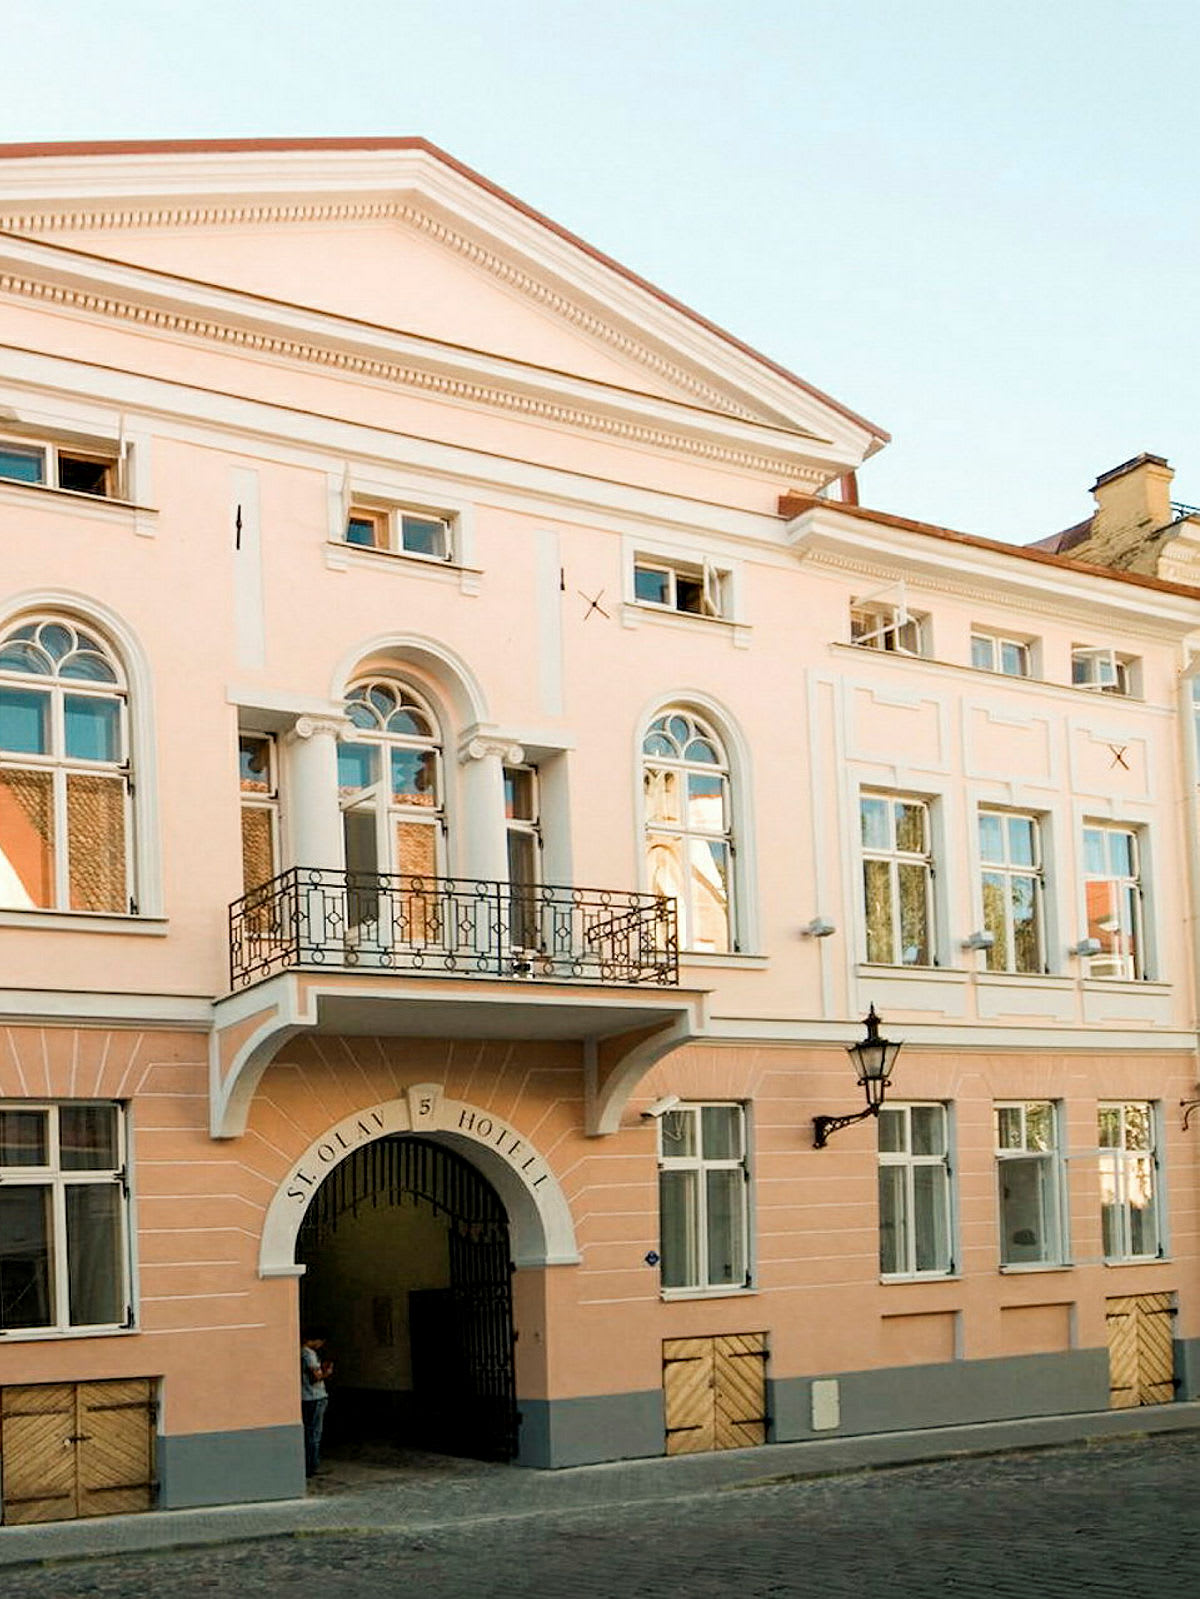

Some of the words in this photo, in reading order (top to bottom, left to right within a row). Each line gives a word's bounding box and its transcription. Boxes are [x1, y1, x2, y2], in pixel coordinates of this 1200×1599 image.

[419, 1098, 431, 1116] 5
[287, 1168, 317, 1204] ST.
[317, 1109, 385, 1163] OLAV
[458, 1109, 548, 1192] HOTELL
